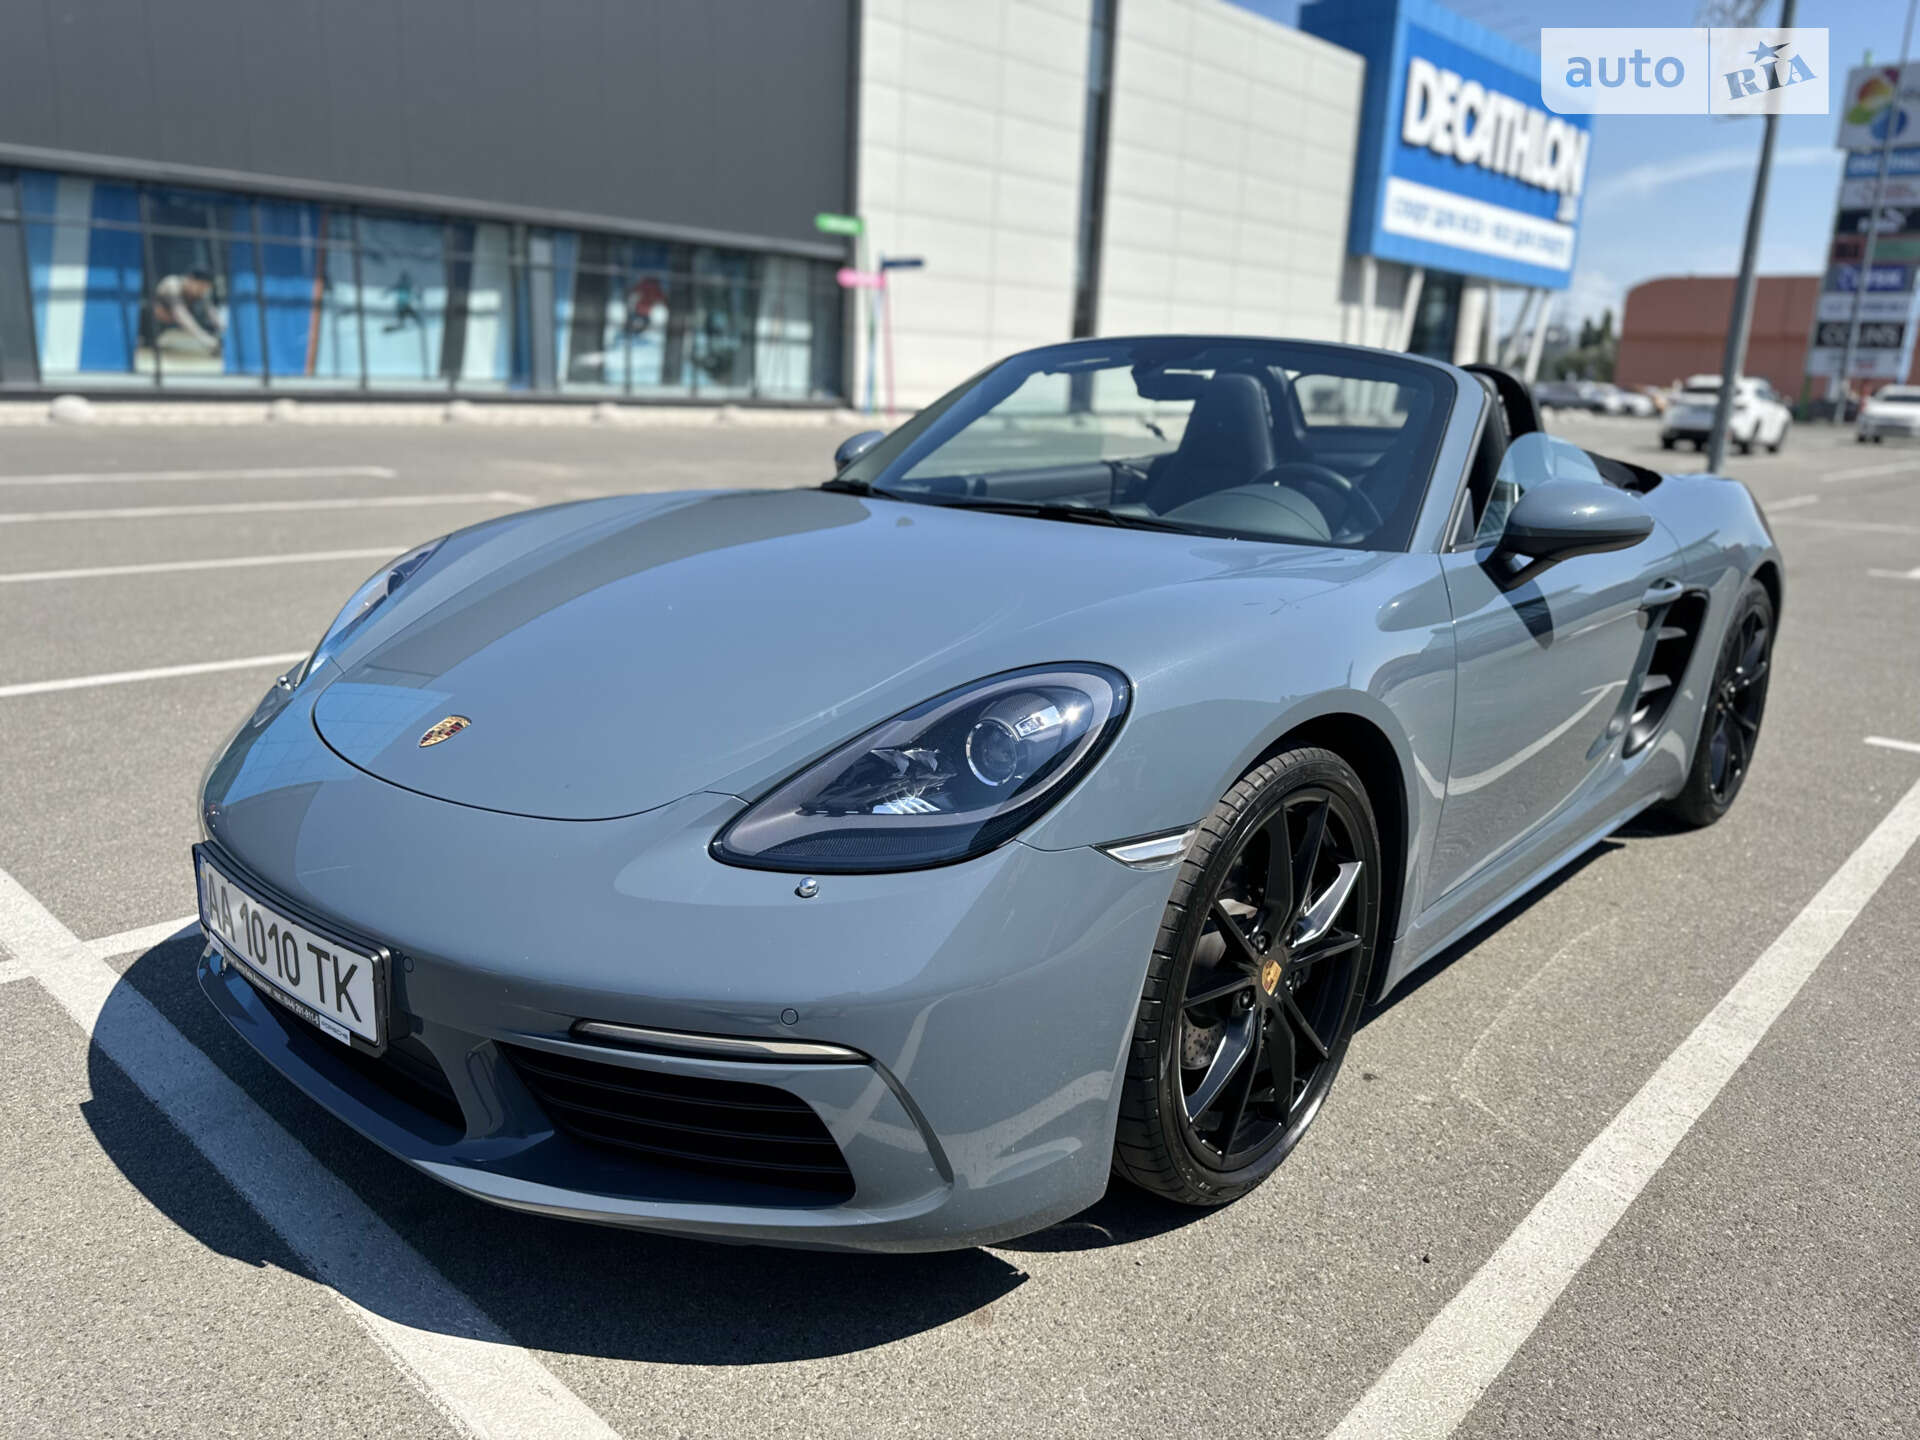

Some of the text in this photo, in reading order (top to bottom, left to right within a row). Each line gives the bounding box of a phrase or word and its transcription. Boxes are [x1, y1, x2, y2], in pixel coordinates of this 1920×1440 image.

[1402, 57, 1589, 196] DECATHLON
[208, 873, 236, 943] AA
[240, 902, 300, 987] 1010
[306, 942, 362, 1023] TK
